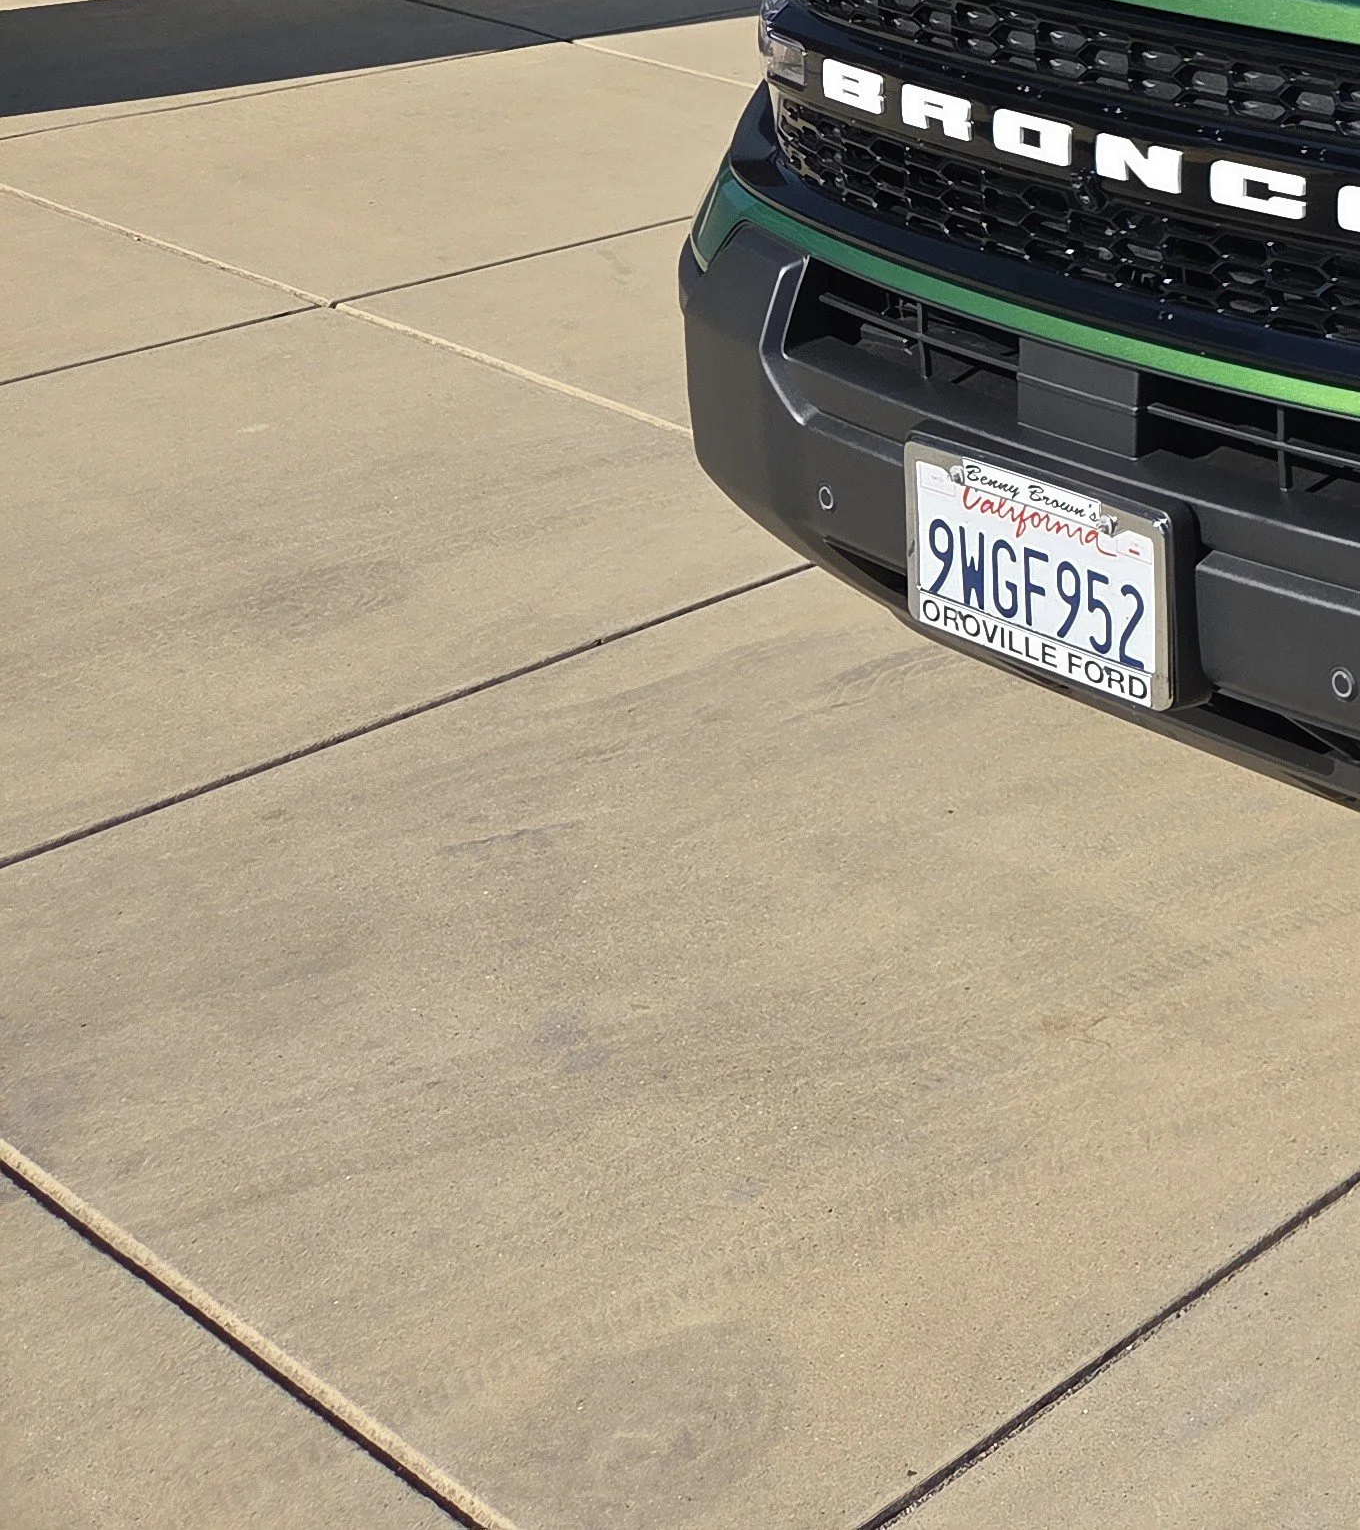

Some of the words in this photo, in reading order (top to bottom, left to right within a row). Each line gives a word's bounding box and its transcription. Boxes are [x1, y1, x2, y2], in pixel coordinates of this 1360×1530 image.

[962, 485, 1118, 558] California
[965, 464, 1019, 499] Benny
[1027, 484, 1100, 522] Brown's
[927, 518, 1145, 670] 9WGF952
[921, 598, 1058, 670] OROVILLE
[1067, 653, 1148, 701] FORD
